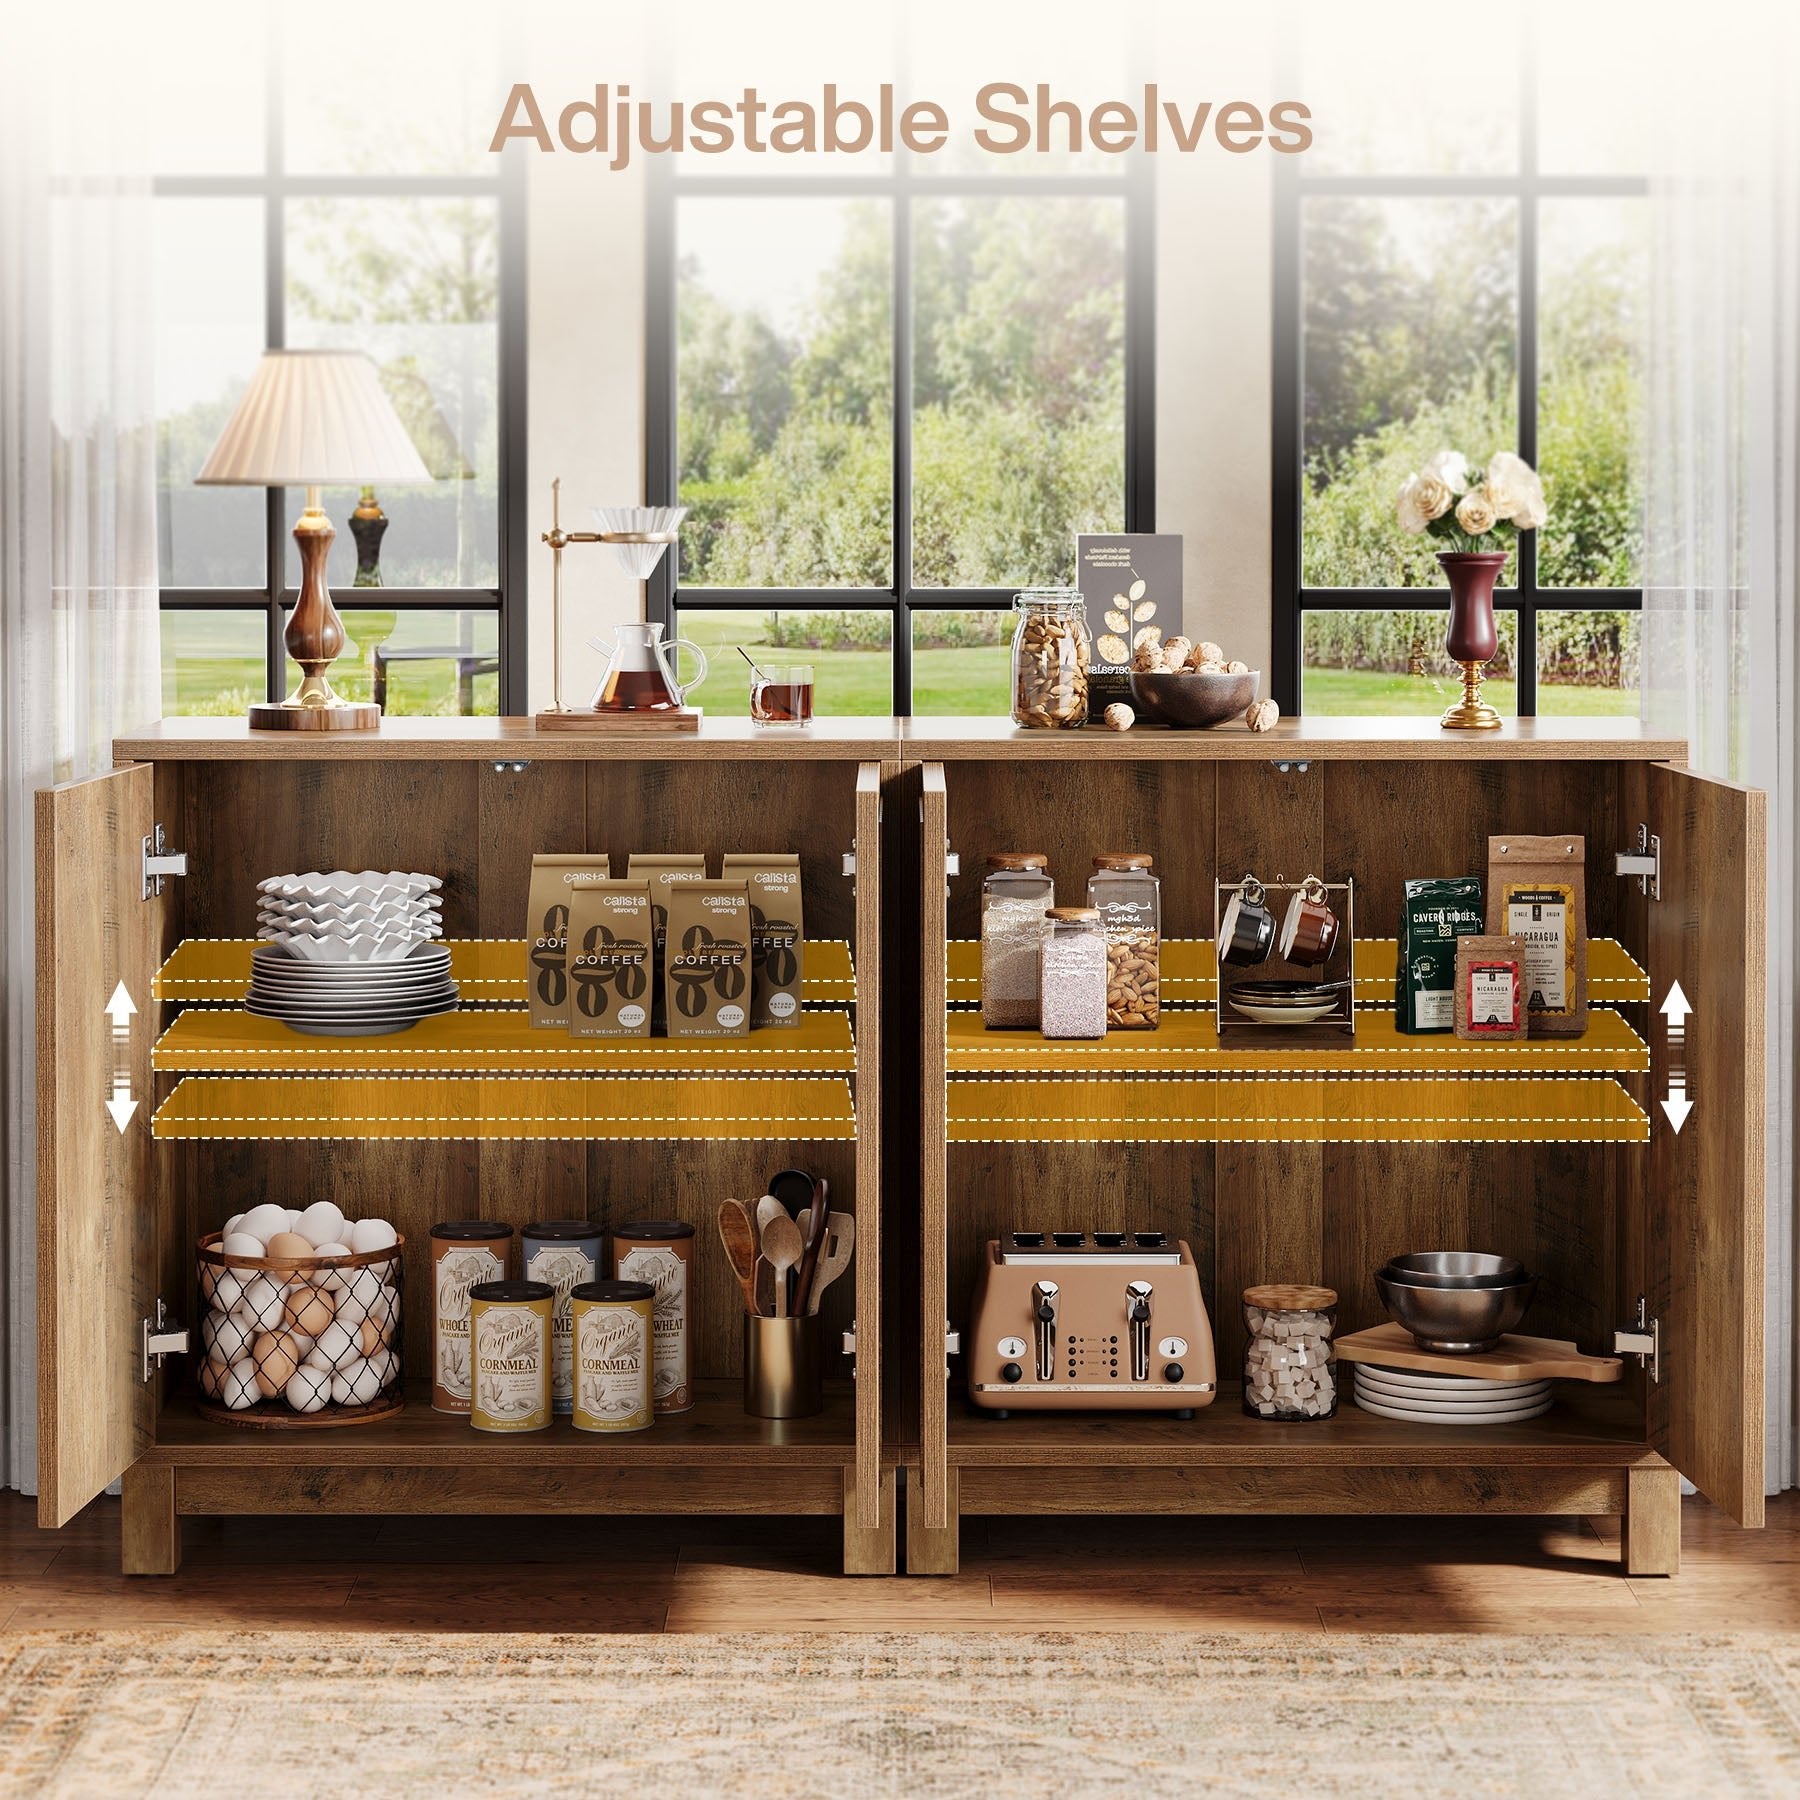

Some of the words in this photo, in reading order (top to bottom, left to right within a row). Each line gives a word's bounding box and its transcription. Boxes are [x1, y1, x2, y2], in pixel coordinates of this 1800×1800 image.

[763, 885, 789, 893] strong
[612, 907, 639, 915] strong
[711, 907, 737, 916] strong
[1447, 911, 1476, 922] RIDGES
[1132, 924, 1156, 933] spice
[536, 937, 568, 948] COF
[752, 937, 793, 948] FFEE
[575, 955, 643, 965] COFFEE
[674, 955, 742, 965] COFFEE
[440, 1318, 469, 1332] WHOLE
[653, 1318, 683, 1331] WHEAT
[479, 1319, 536, 1358] Organic
[581, 1319, 638, 1357] Organic
[480, 1358, 538, 1371] CORNMEAL
[582, 1358, 641, 1371] CORNMEAL
